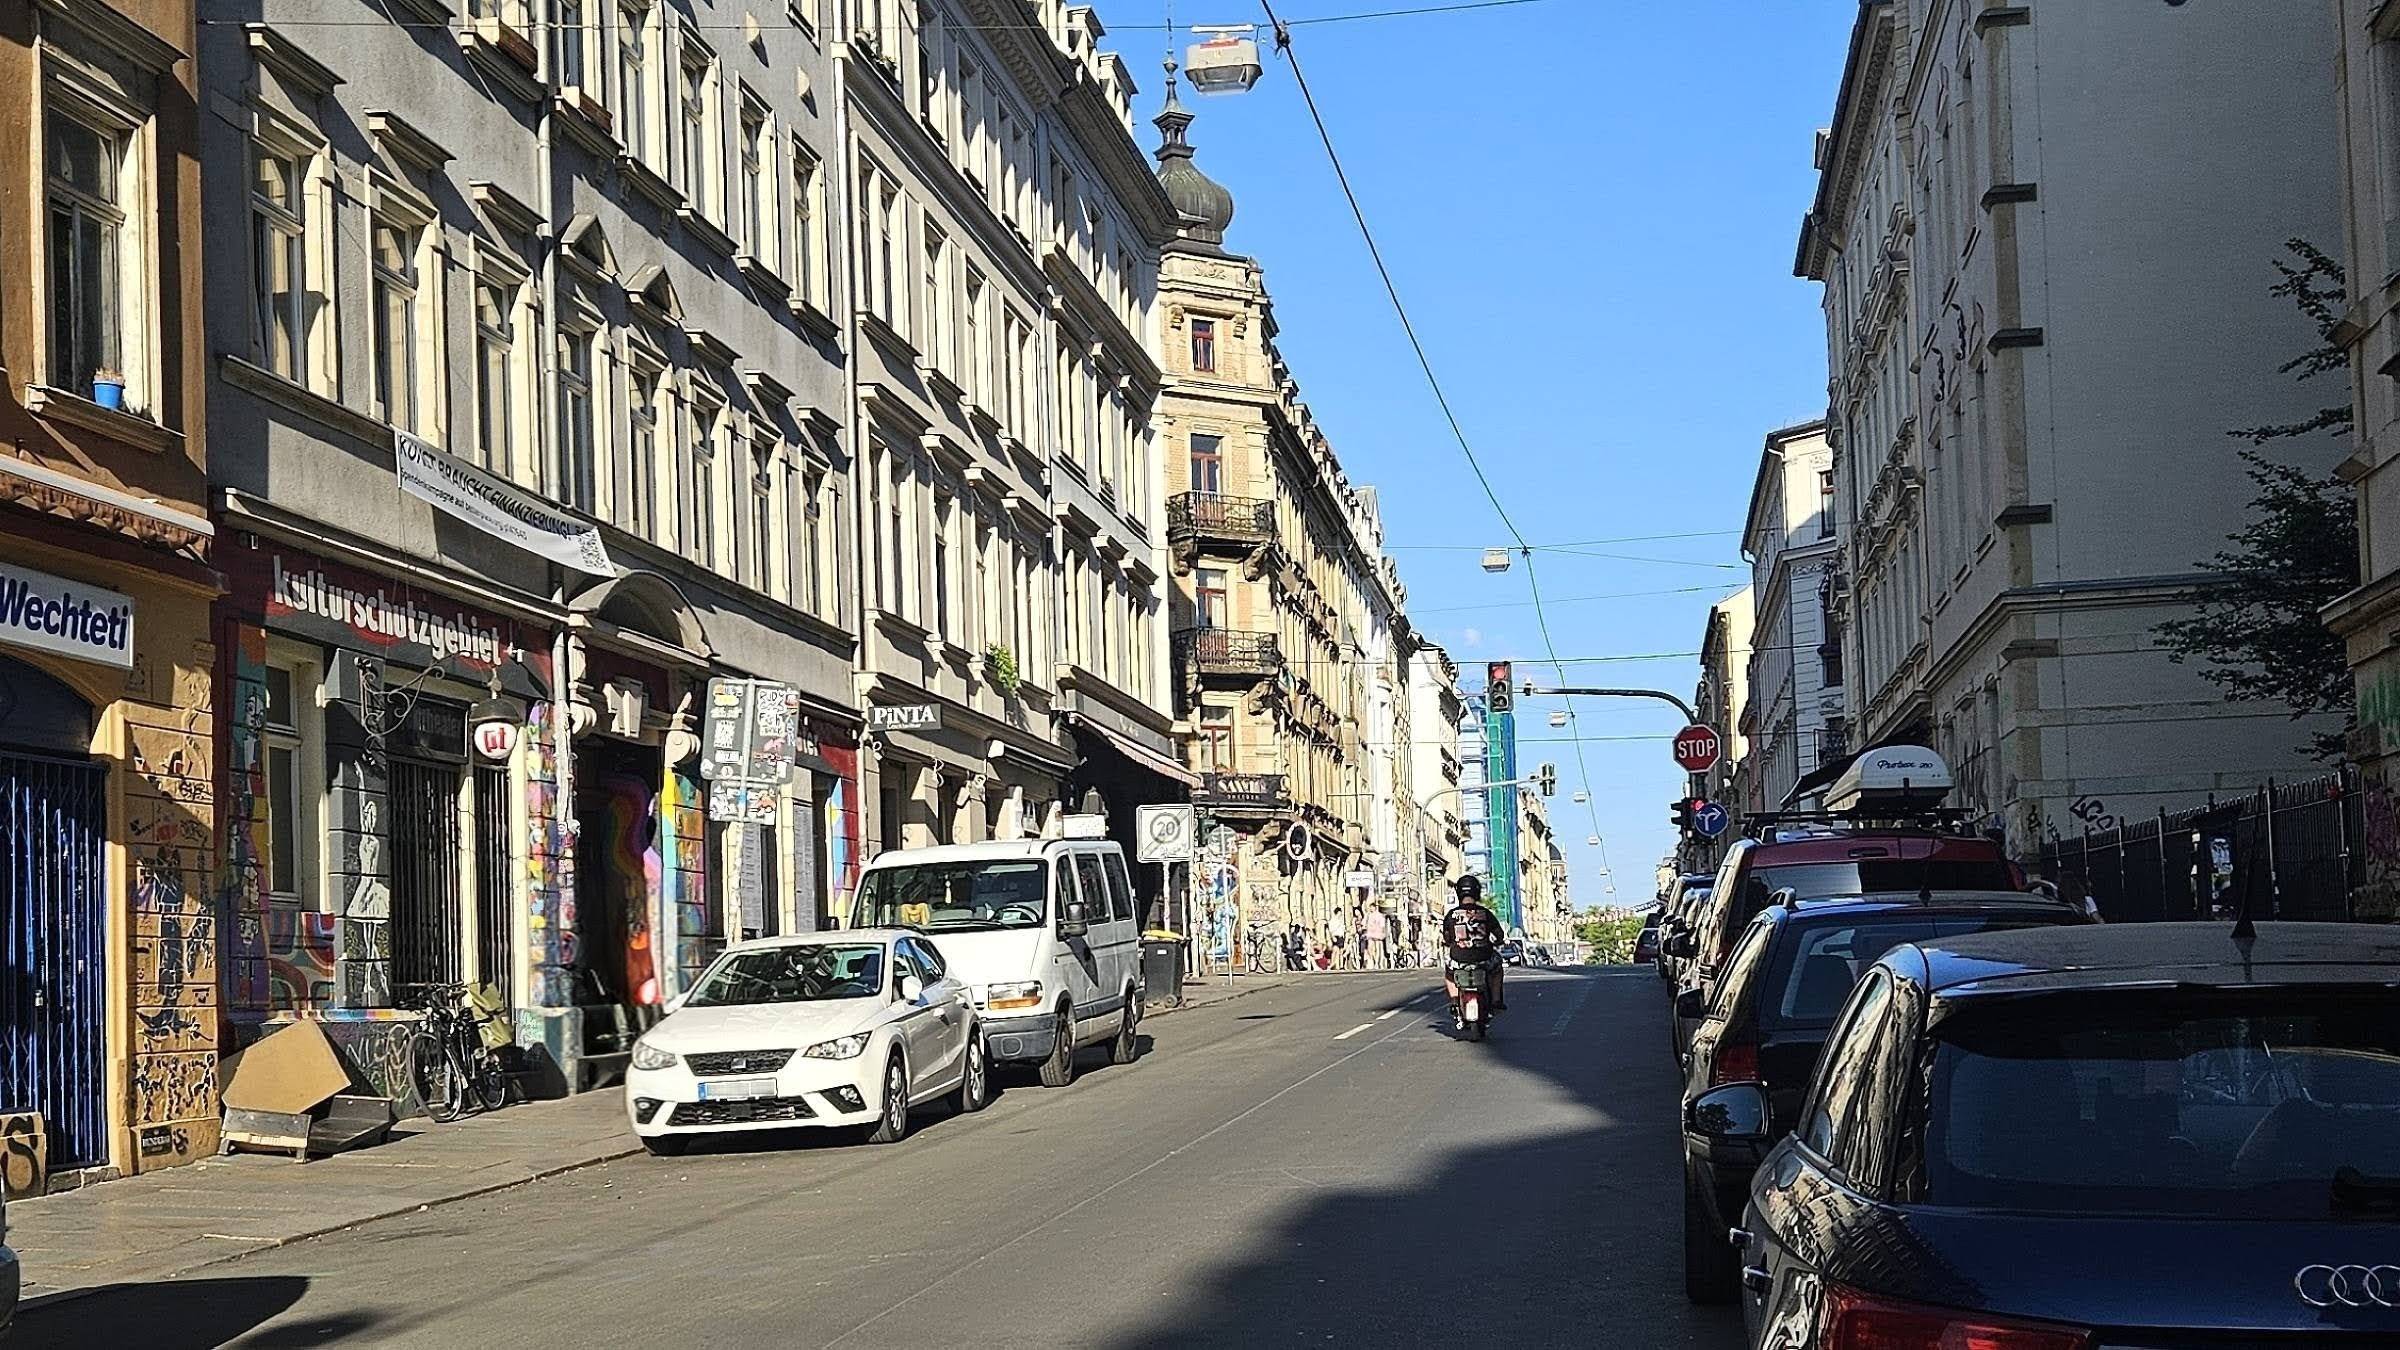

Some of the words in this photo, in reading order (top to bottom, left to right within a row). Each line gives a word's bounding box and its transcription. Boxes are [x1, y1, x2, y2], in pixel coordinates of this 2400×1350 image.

[438, 460, 493, 500] BRAUCHT
[0, 576, 129, 651] Wechteti
[273, 554, 502, 666] kulturschutzgebiet
[1677, 738, 1715, 759] STOP
[1157, 821, 1175, 837] 20
